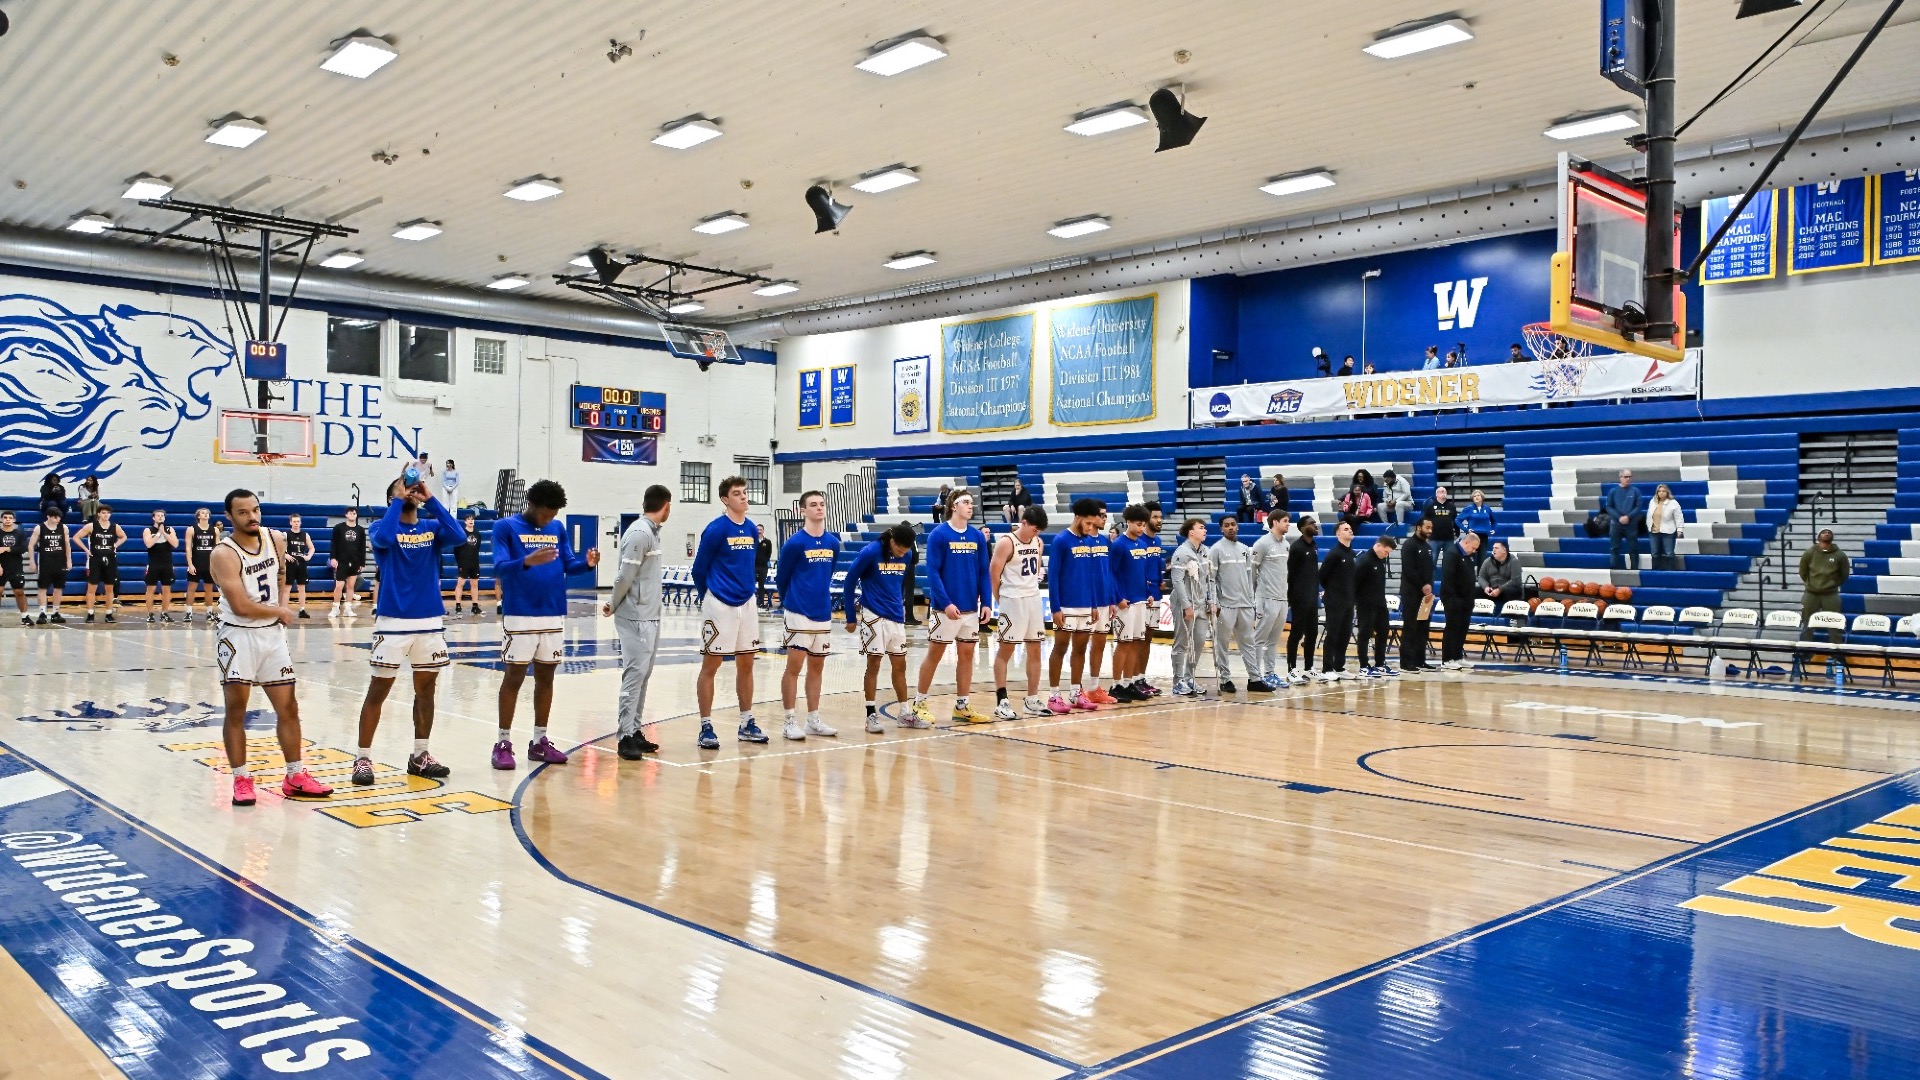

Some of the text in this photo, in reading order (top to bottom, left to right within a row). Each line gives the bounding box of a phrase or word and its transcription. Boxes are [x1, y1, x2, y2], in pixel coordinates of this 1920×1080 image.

[1813, 200, 1845, 208] FOOTBALL
[1900, 200, 1920, 212] NC
[1815, 211, 1842, 224] MAC
[1909, 222, 1920, 230] 197
[1726, 225, 1750, 236] MAC
[1800, 221, 1859, 235] CHAMPIONS
[1717, 234, 1766, 247] HAMPIONS
[1434, 277, 1488, 331] W
[1057, 316, 1146, 338] Widener University
[954, 332, 1021, 353] Widener College
[1060, 339, 1135, 361] NCAA Football
[952, 352, 1018, 374] NCAA Football
[1060, 365, 1140, 386] Division III 1981
[950, 380, 984, 396] Division
[987, 377, 998, 392] III
[1343, 373, 1480, 409] WIDENER
[289, 379, 383, 420] THE
[946, 399, 1027, 417] National Champions
[1057, 390, 1150, 409] National Champions
[1211, 404, 1231, 413] NCAA
[1269, 401, 1300, 413] MAC
[591, 412, 599, 426] 0
[654, 417, 660, 430] 0
[320, 422, 423, 460] DEN
[1021, 557, 1037, 577] 20
[257, 574, 271, 602] 5
[1814, 615, 1842, 624] Widener
[1859, 618, 1886, 627] Widener
[0, 831, 372, 1073] @WidenerSports
